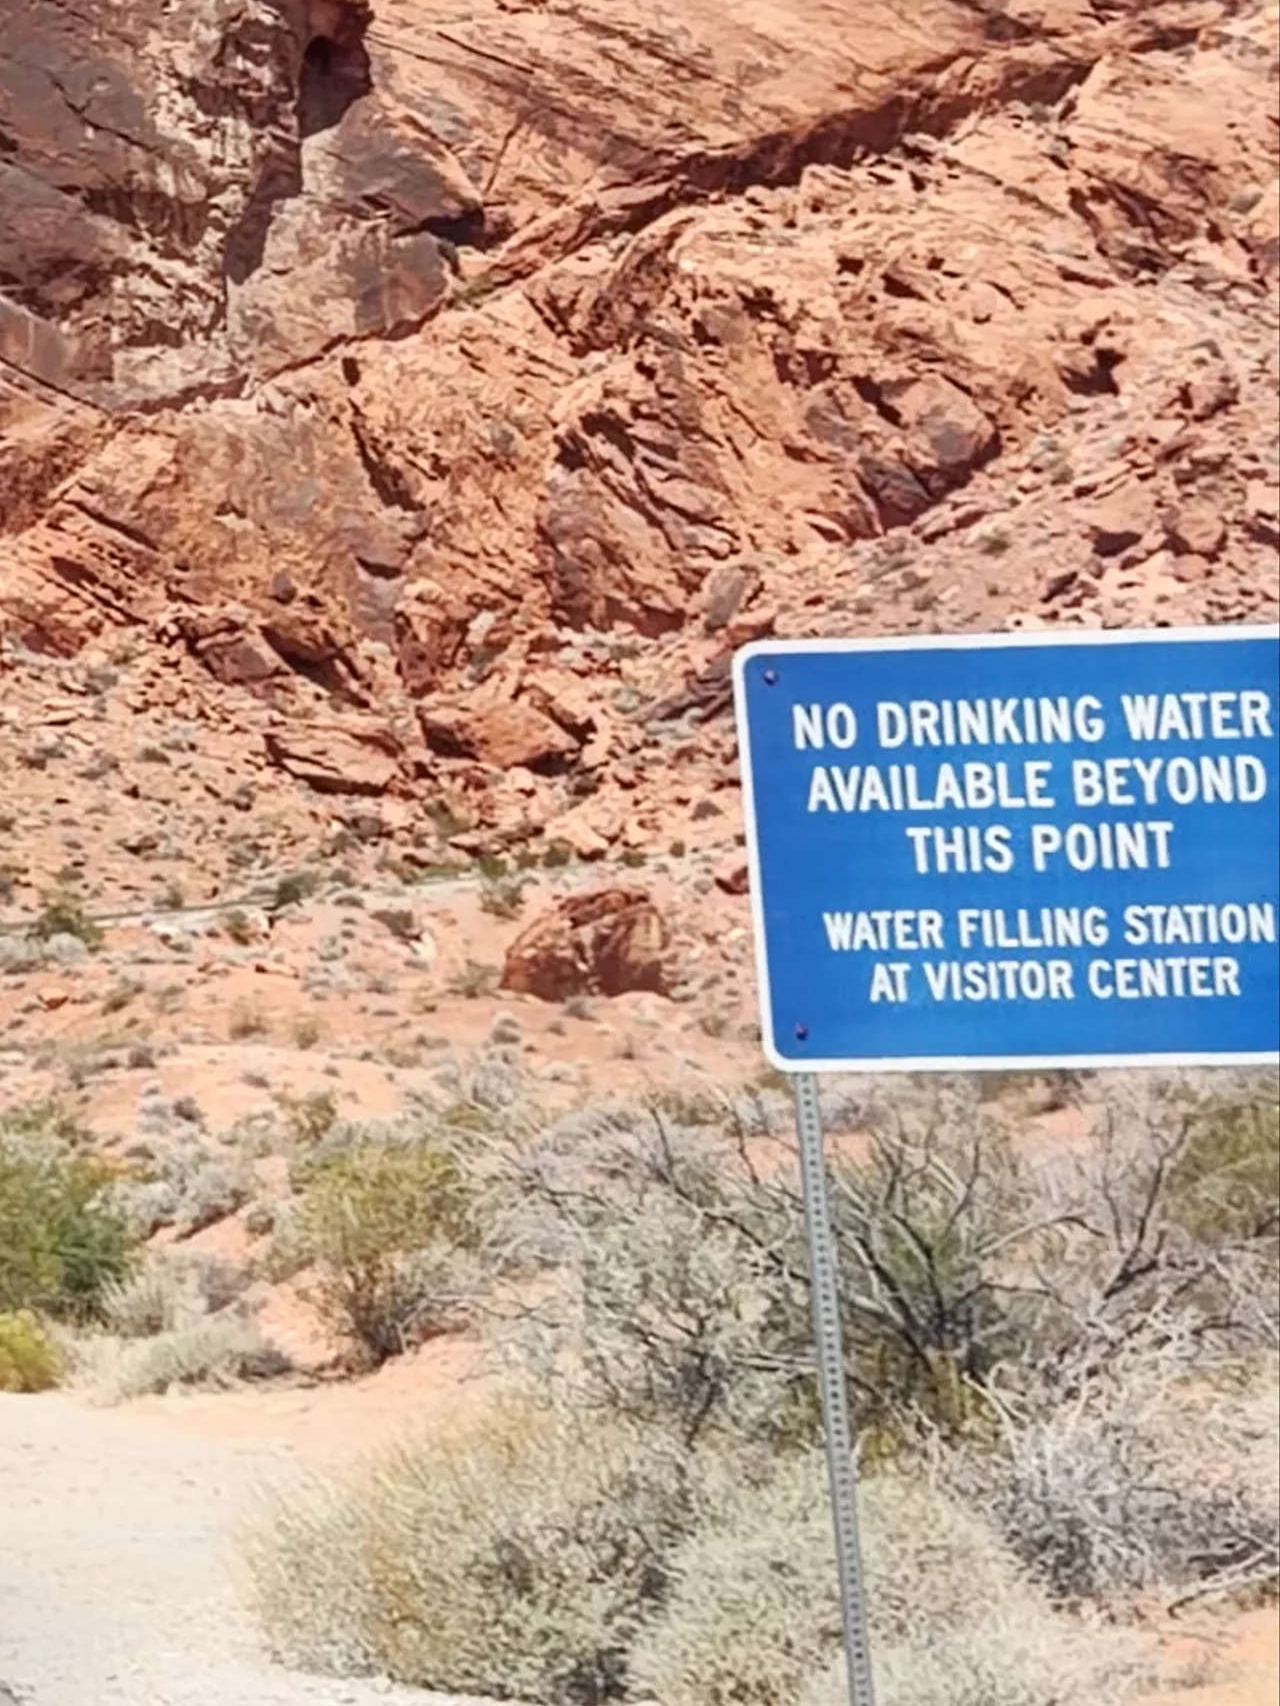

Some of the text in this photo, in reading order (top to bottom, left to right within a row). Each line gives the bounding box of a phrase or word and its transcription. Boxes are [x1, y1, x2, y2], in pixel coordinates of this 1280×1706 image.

[792, 690, 1274, 750] NO DRINKING WATER
[807, 754, 1267, 813] AVAILABLE BEYOND
[905, 821, 1174, 875] THIS POINT
[822, 902, 1276, 952] WATER FILLING STATION
[869, 956, 1241, 1003] AT VISITOR CENTER
